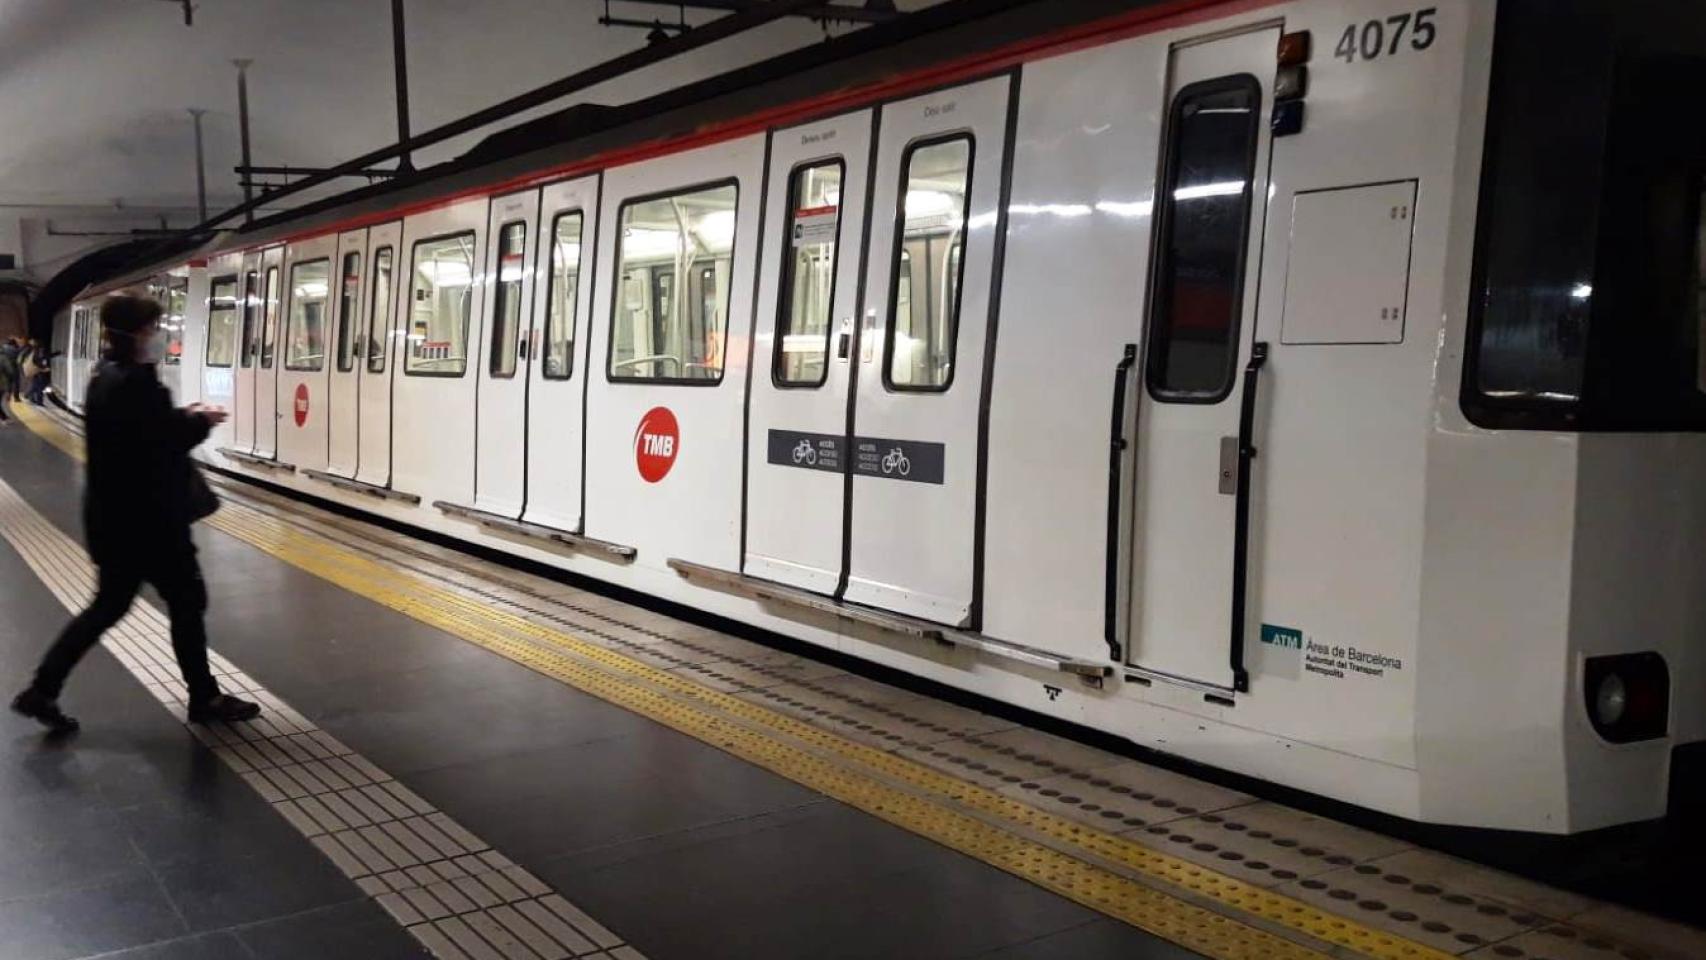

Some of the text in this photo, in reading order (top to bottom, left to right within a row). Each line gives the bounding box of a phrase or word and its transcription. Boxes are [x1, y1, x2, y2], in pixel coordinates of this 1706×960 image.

[1334, 6, 1437, 63] 4075
[643, 433, 674, 457] TMB
[1273, 633, 1299, 649] ATM
[1332, 644, 1346, 659] de
[1348, 647, 1401, 669] Barcelona
